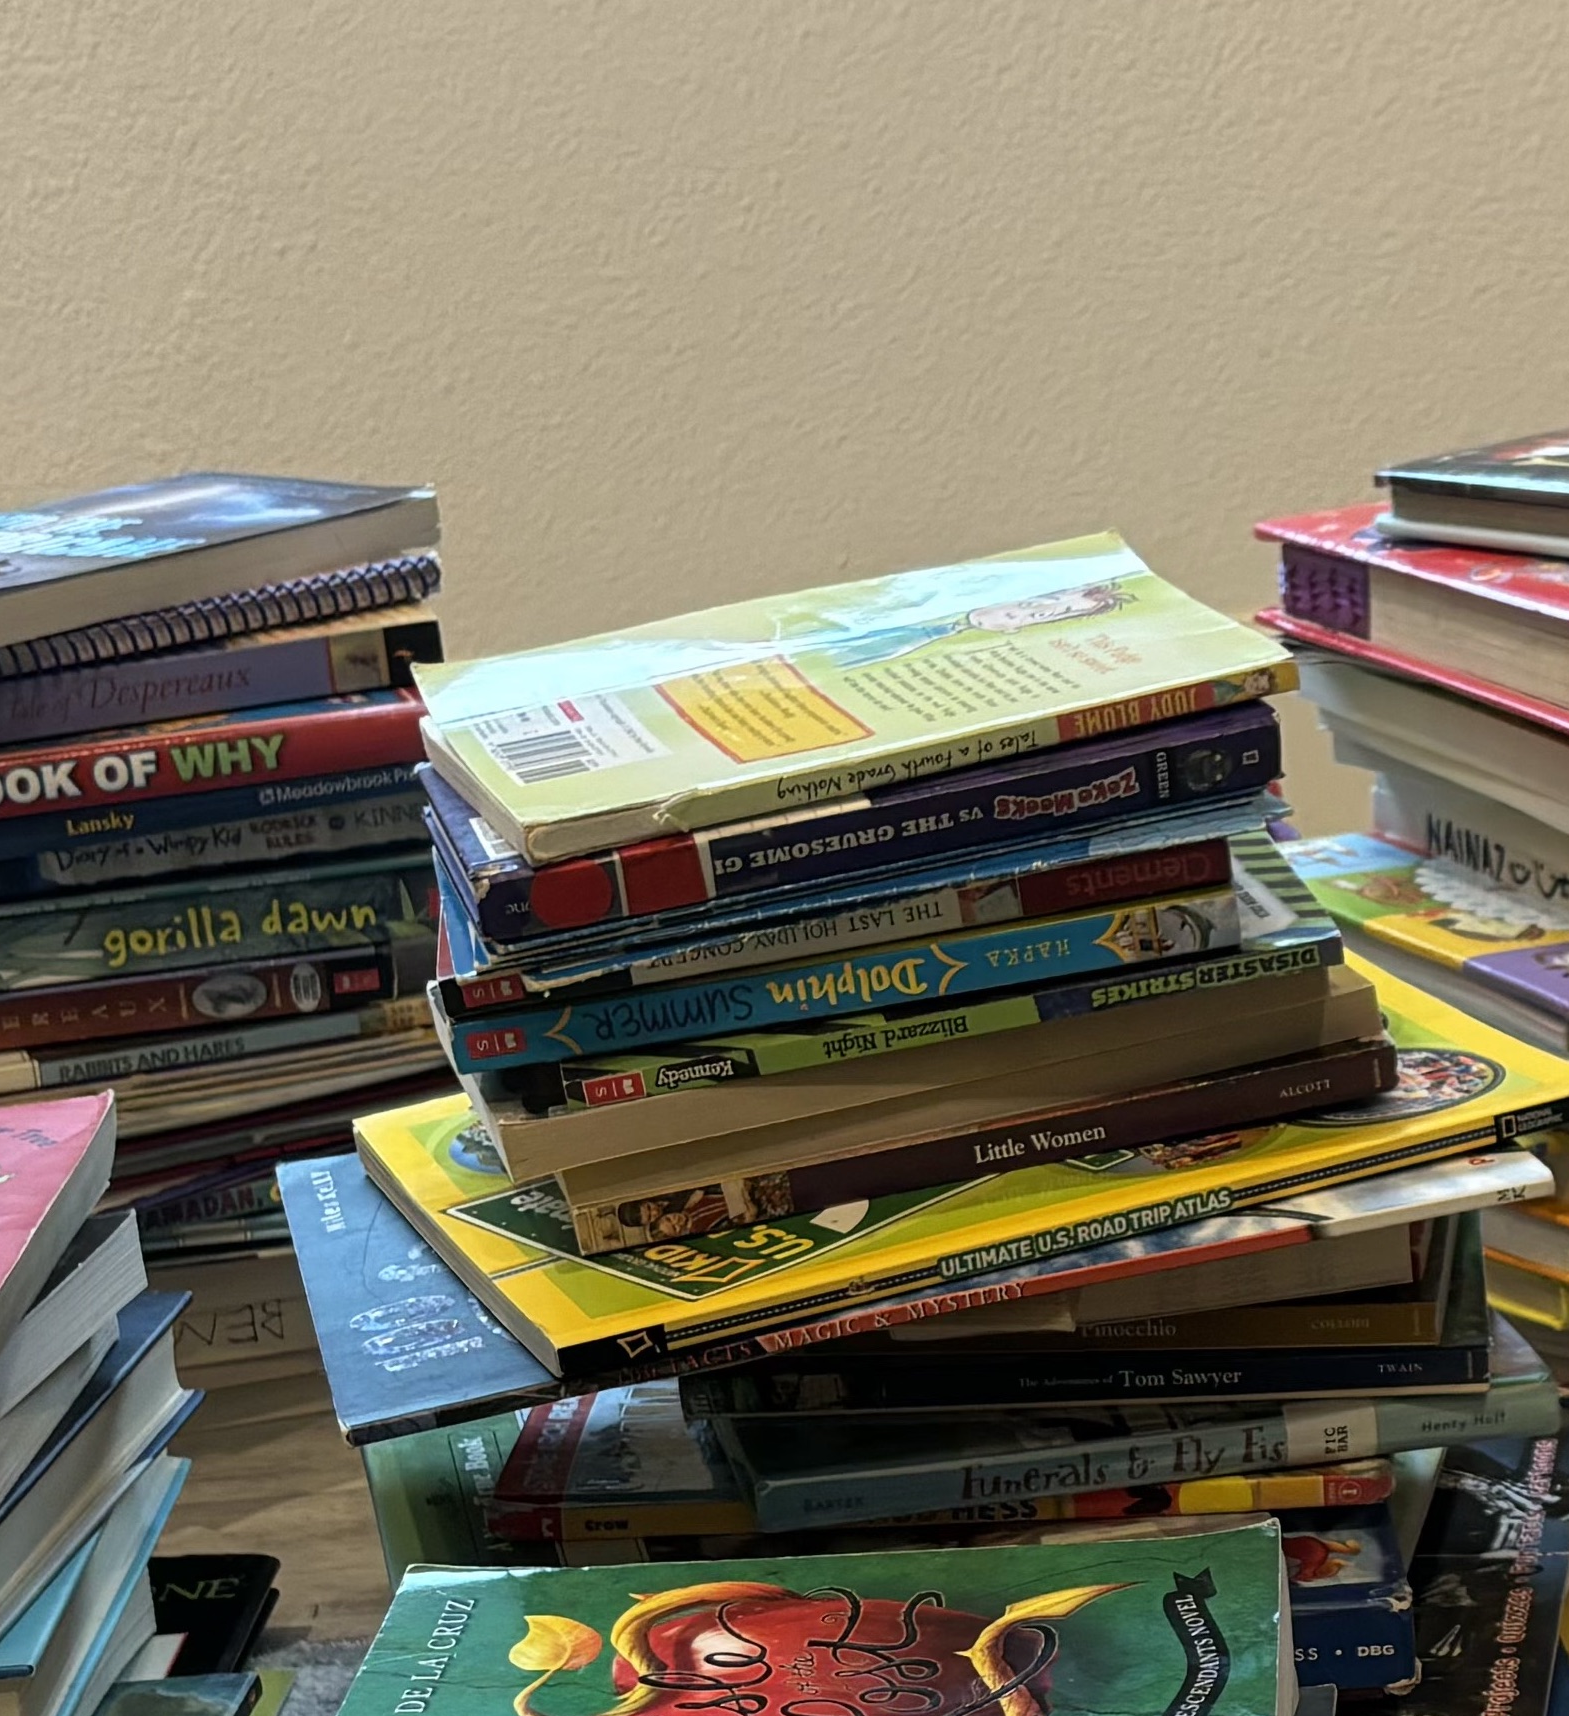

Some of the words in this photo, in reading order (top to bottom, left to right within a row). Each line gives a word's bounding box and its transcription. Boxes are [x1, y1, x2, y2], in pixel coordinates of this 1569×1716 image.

[1072, 698, 1142, 738] BLUME
[1147, 687, 1198, 720] JUDY
[92, 747, 158, 794] OF
[168, 733, 286, 784] WHY
[66, 811, 135, 838] Lansky
[102, 912, 242, 967] gorilla
[262, 900, 378, 935] dawn
[1195, 945, 1321, 990] DISASTER
[1089, 970, 1197, 1008] STRIKES
[822, 1029, 880, 1059] Night
[883, 1014, 971, 1050] Blizzard
[58, 1055, 134, 1085] RABBITS
[136, 1046, 179, 1068] AND
[655, 1058, 735, 1090] Kennedy
[973, 1139, 1026, 1166] Little
[1031, 1122, 1108, 1154] Women
[939, 1236, 1033, 1280] ULTIMATE
[1035, 1223, 1075, 1256] U.S.
[1076, 1215, 1129, 1247] ROAD
[1130, 1205, 1171, 1234] TRIP
[1171, 1187, 1233, 1224] ATLAS
[1117, 1367, 1167, 1390] Tom
[1171, 1366, 1243, 1392] Sawyer
[426, 1598, 477, 1652] CRUZ
[410, 1652, 450, 1682] LA
[393, 1686, 433, 1714] DE
